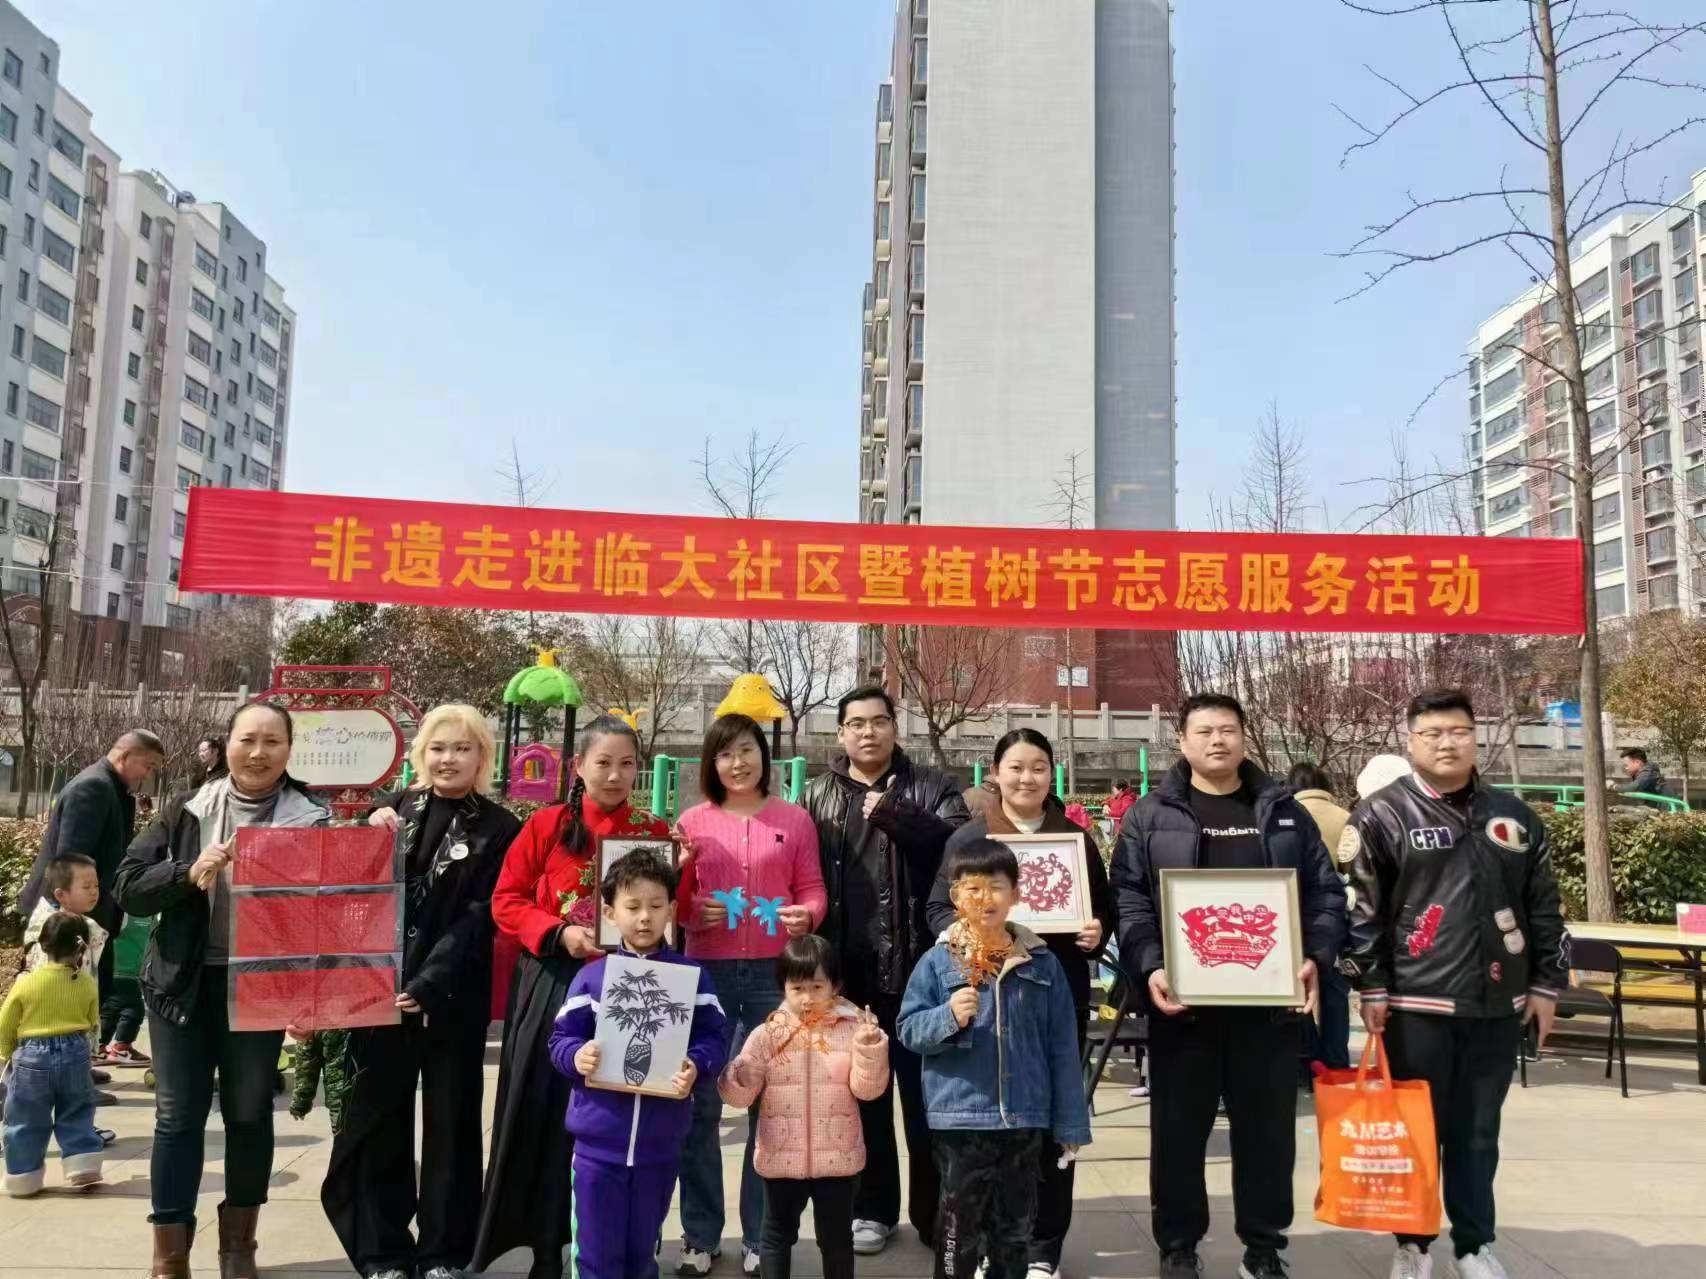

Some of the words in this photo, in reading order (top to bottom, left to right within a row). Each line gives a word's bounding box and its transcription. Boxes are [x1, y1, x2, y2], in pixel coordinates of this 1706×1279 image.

[310, 517, 1482, 617] 非遗走进临大社区暨植树节志愿服务活动
